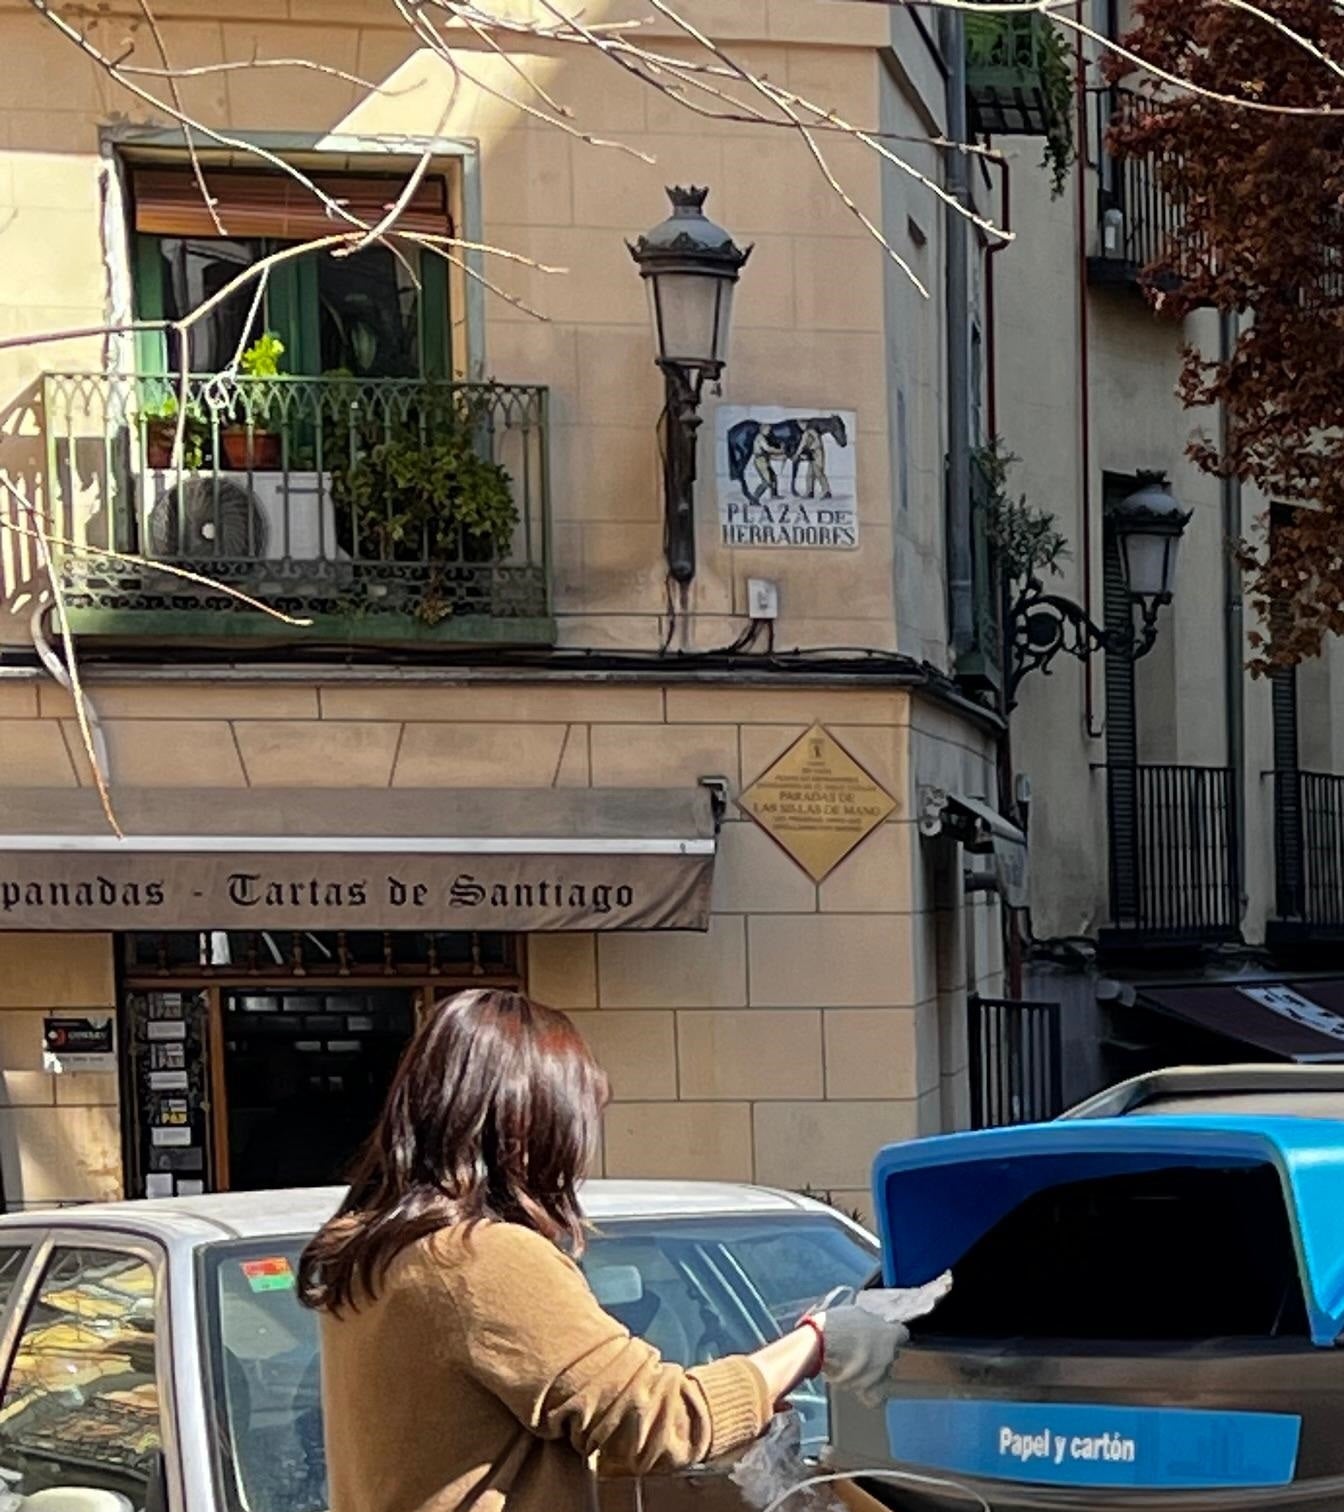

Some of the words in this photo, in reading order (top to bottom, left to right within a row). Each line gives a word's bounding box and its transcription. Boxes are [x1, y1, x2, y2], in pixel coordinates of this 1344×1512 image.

[728, 502, 810, 524] PLAZA
[817, 510, 853, 525] DE
[722, 524, 856, 545] HERRADORES
[1, 876, 165, 912] panadas
[226, 873, 368, 907] Tartas
[387, 876, 429, 907] de
[450, 873, 634, 914] Santiago
[1000, 1426, 1050, 1462] Papel
[1054, 1436, 1067, 1464] y
[1070, 1432, 1135, 1462] cartón
